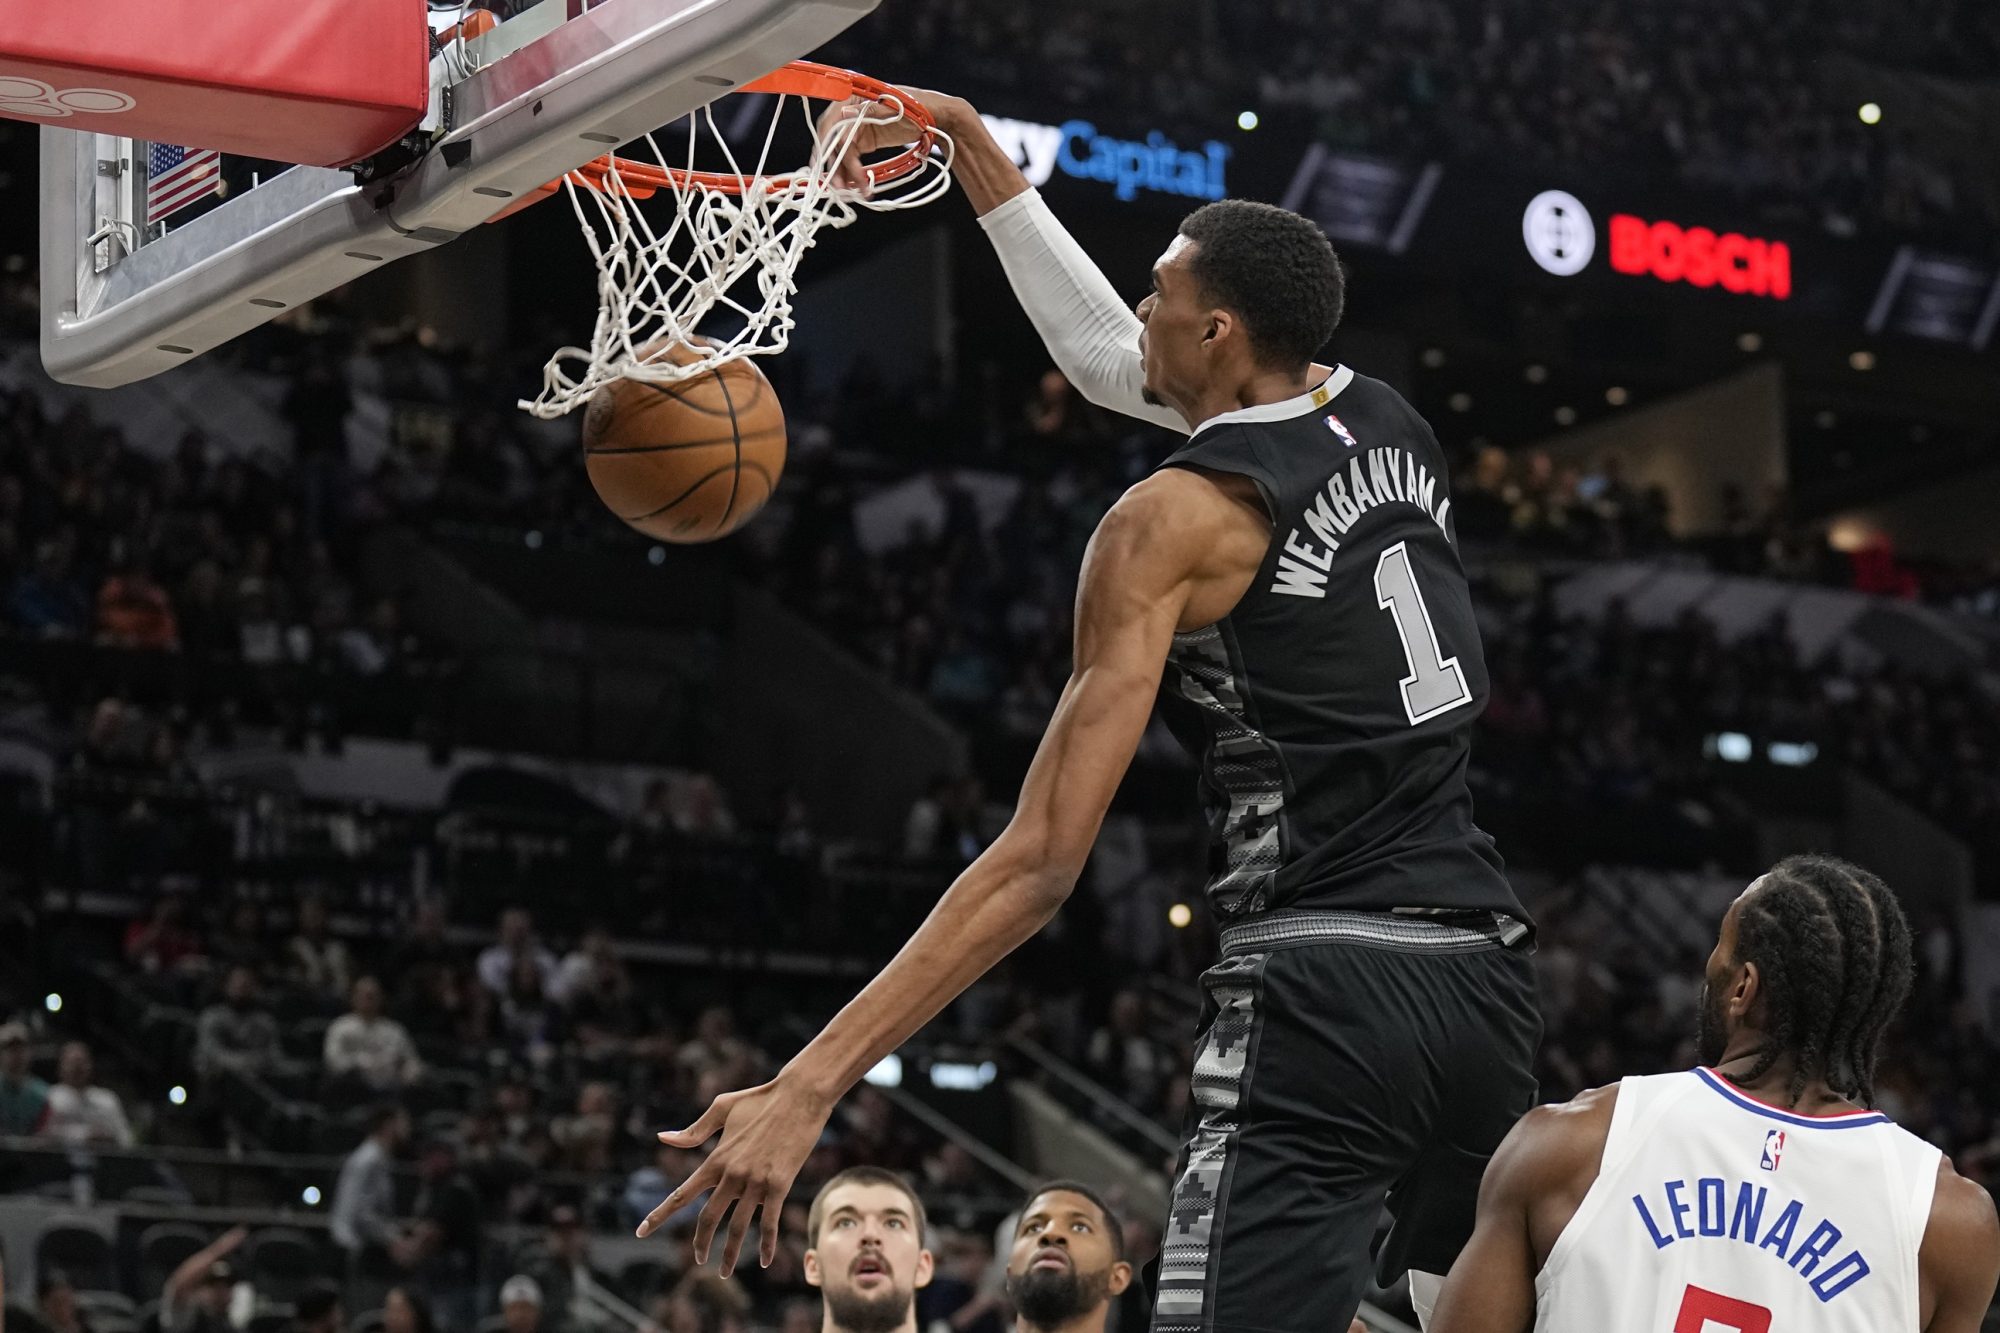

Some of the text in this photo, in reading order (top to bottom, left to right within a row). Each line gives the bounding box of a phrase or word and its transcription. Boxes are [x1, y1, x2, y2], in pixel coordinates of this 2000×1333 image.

[1056, 120, 1229, 201] Capital
[1609, 213, 1792, 300] BOSCH
[1373, 540, 1473, 727] 1
[1632, 1177, 1871, 1303] LEONARD
